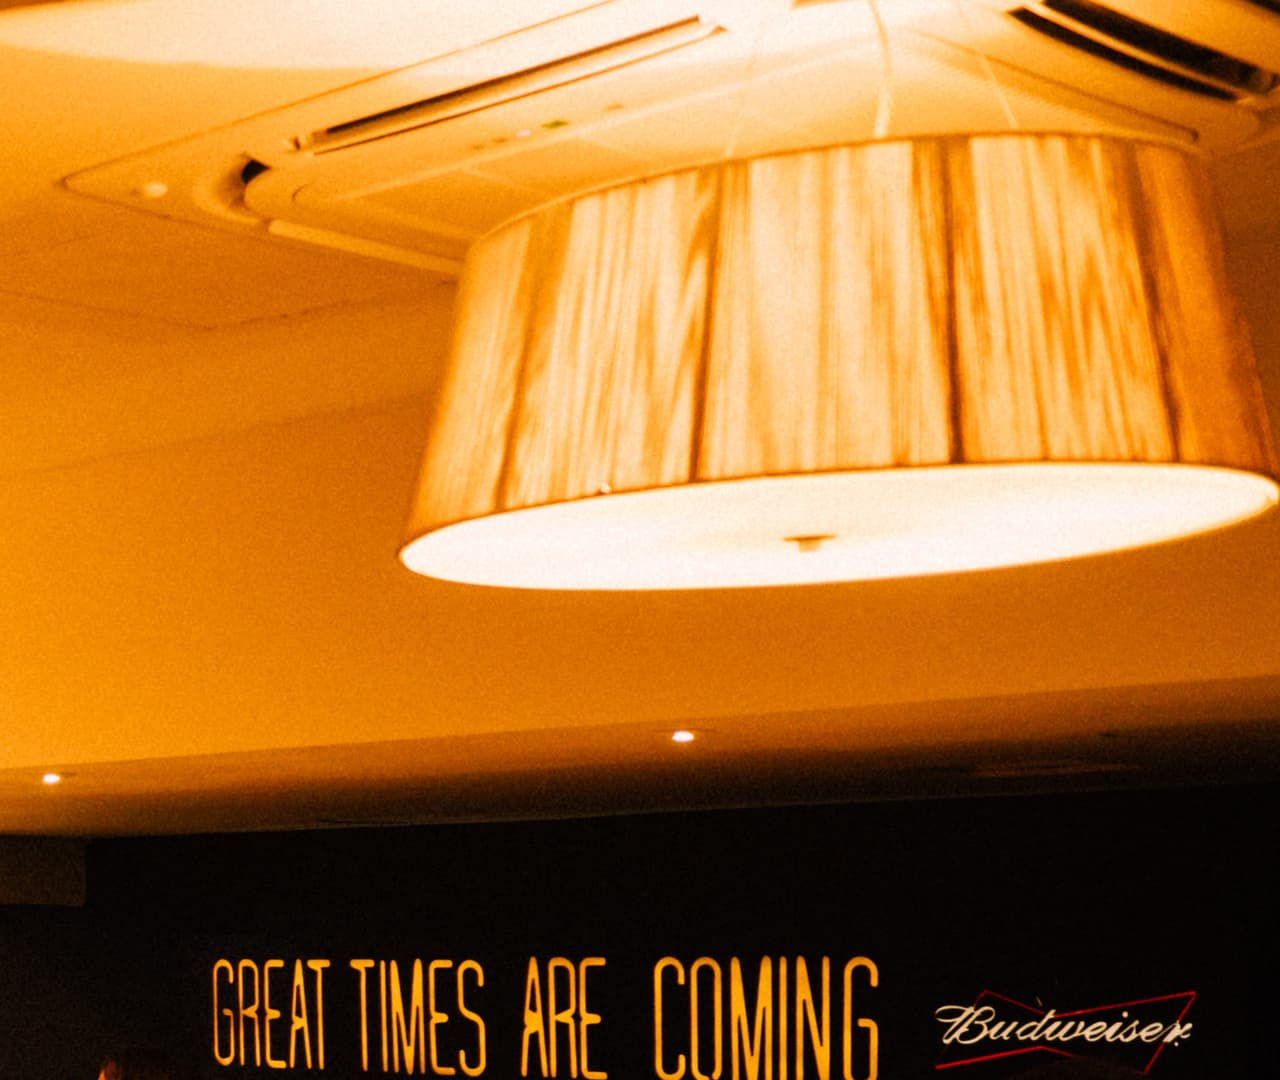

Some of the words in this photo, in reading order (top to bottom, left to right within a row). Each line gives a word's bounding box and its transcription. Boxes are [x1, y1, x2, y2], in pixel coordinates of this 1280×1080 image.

[211, 957, 331, 1071] GREAT
[349, 957, 487, 1077] TIMES
[520, 957, 609, 1080] ARE
[934, 1005, 1194, 1048] Budweiser
